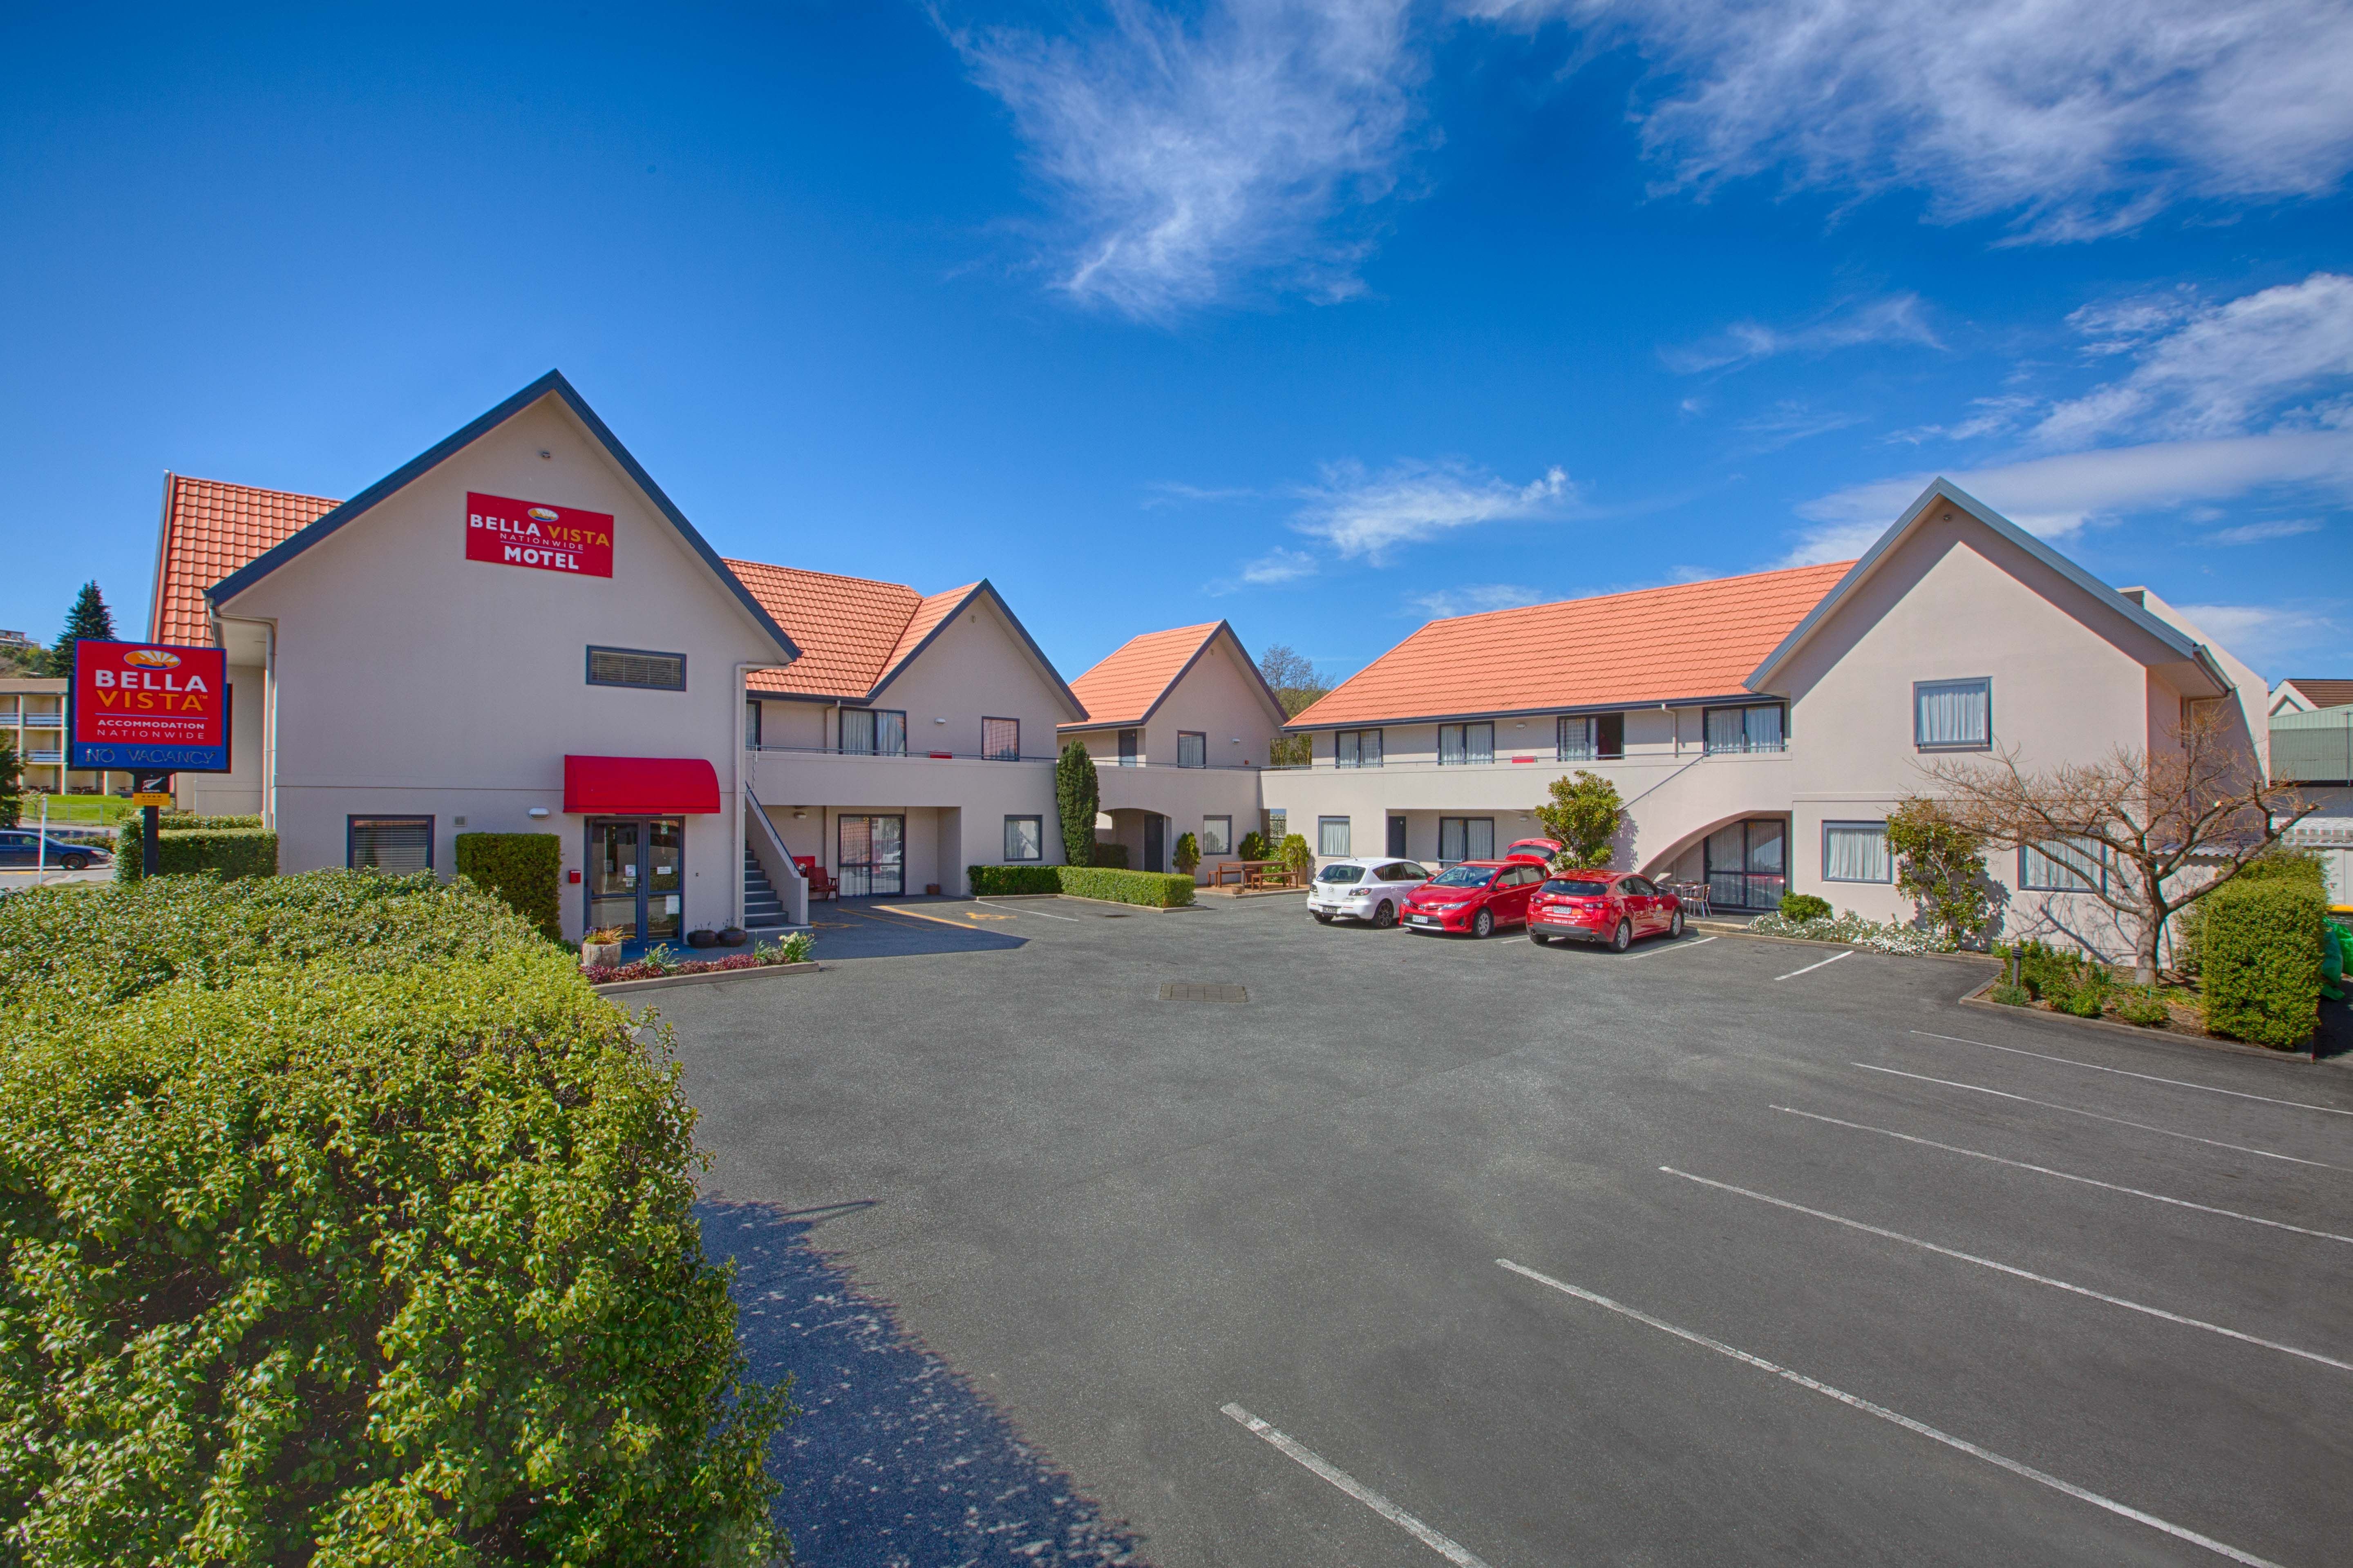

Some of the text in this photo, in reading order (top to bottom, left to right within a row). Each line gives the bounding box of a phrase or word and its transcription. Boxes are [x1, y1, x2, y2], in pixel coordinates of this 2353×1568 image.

[470, 514, 610, 547] BELLA VISTA
[500, 533, 584, 550] NATIONWIDE
[504, 545, 579, 570] MOTEL
[95, 669, 208, 692] BELLA
[98, 719, 204, 729] ACCOMMODATION
[97, 729, 204, 739] NATIONWIDE
[85, 748, 216, 764] NO VACANCY
